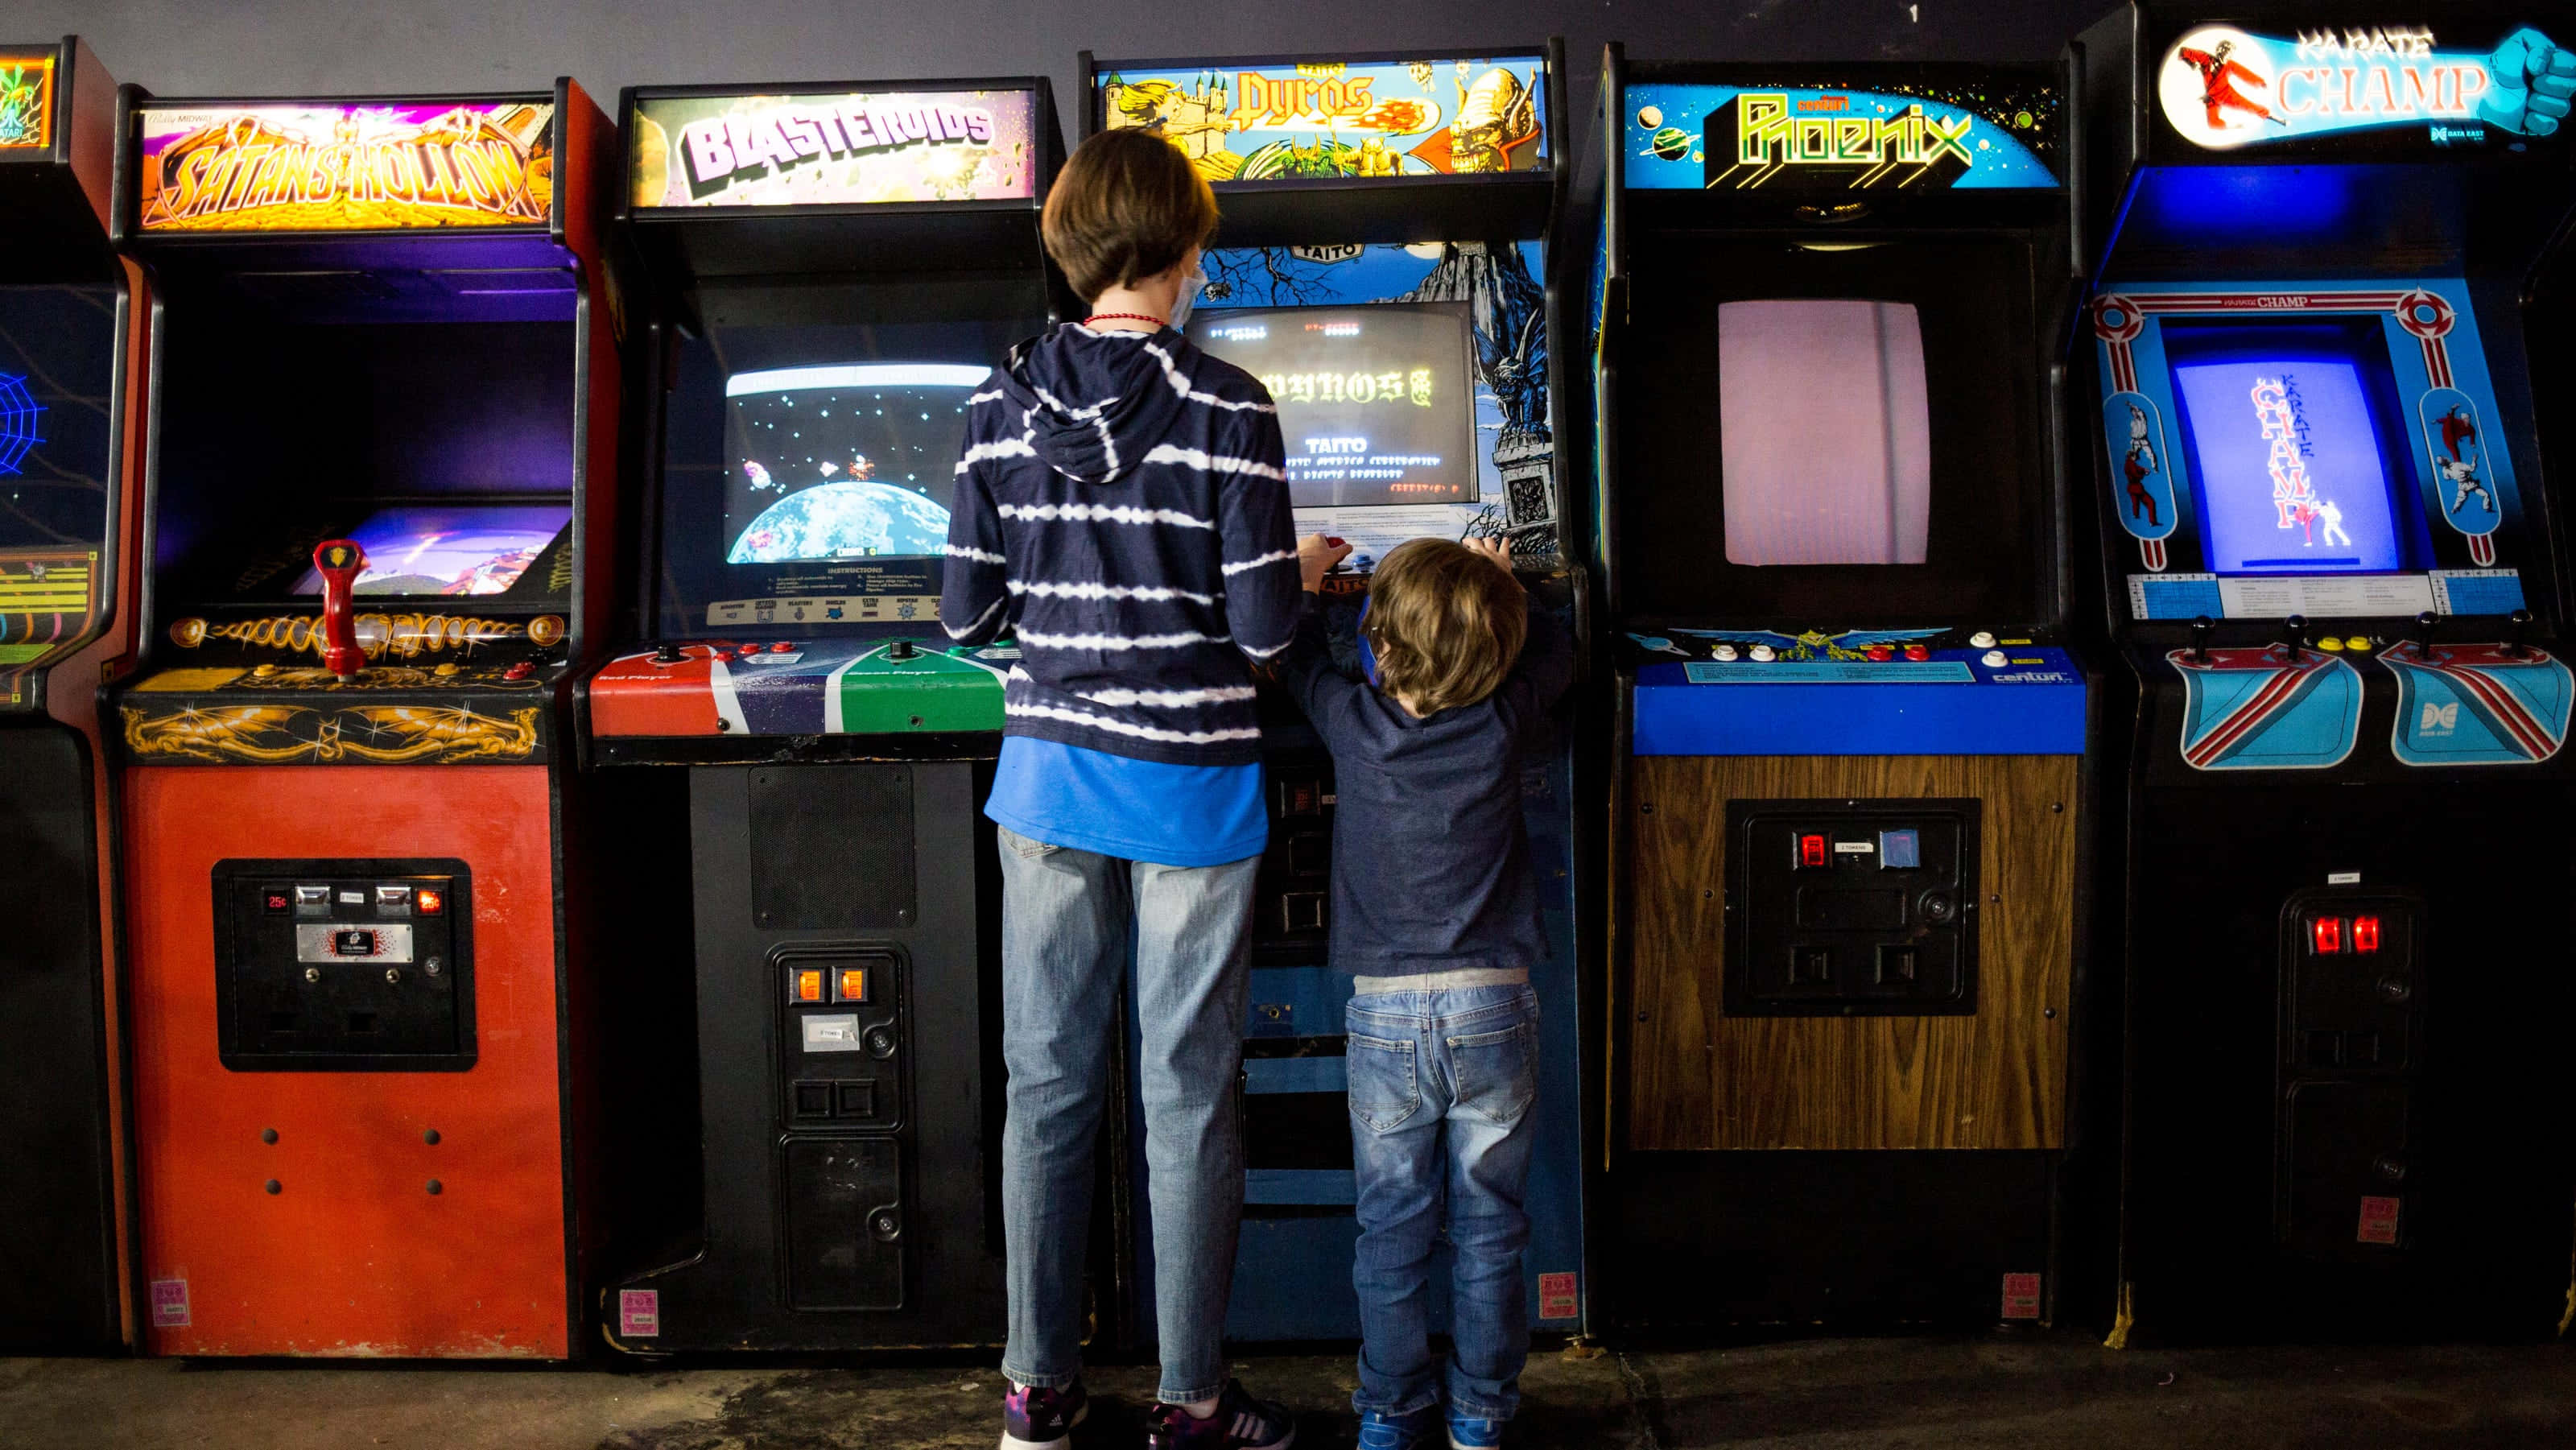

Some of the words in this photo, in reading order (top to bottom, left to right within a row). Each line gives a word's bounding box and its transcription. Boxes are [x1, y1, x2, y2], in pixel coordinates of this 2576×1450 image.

[2295, 26, 2435, 60] KARATE
[2277, 65, 2488, 114] CHAMP
[177, 114, 213, 123] MIDWAY
[1738, 93, 1972, 167] Phoenix
[0, 129, 23, 138] ATARI
[681, 108, 993, 198] BLASTEROIDS
[143, 143, 337, 225] SATANS
[349, 143, 543, 221] HOLLOW
[1301, 244, 1356, 260] TAITO
[2257, 296, 2309, 308] CHAMP
[2282, 374, 2314, 457] KARATE
[1305, 437, 1368, 454] TAITO
[268, 895, 287, 908] 25¢
